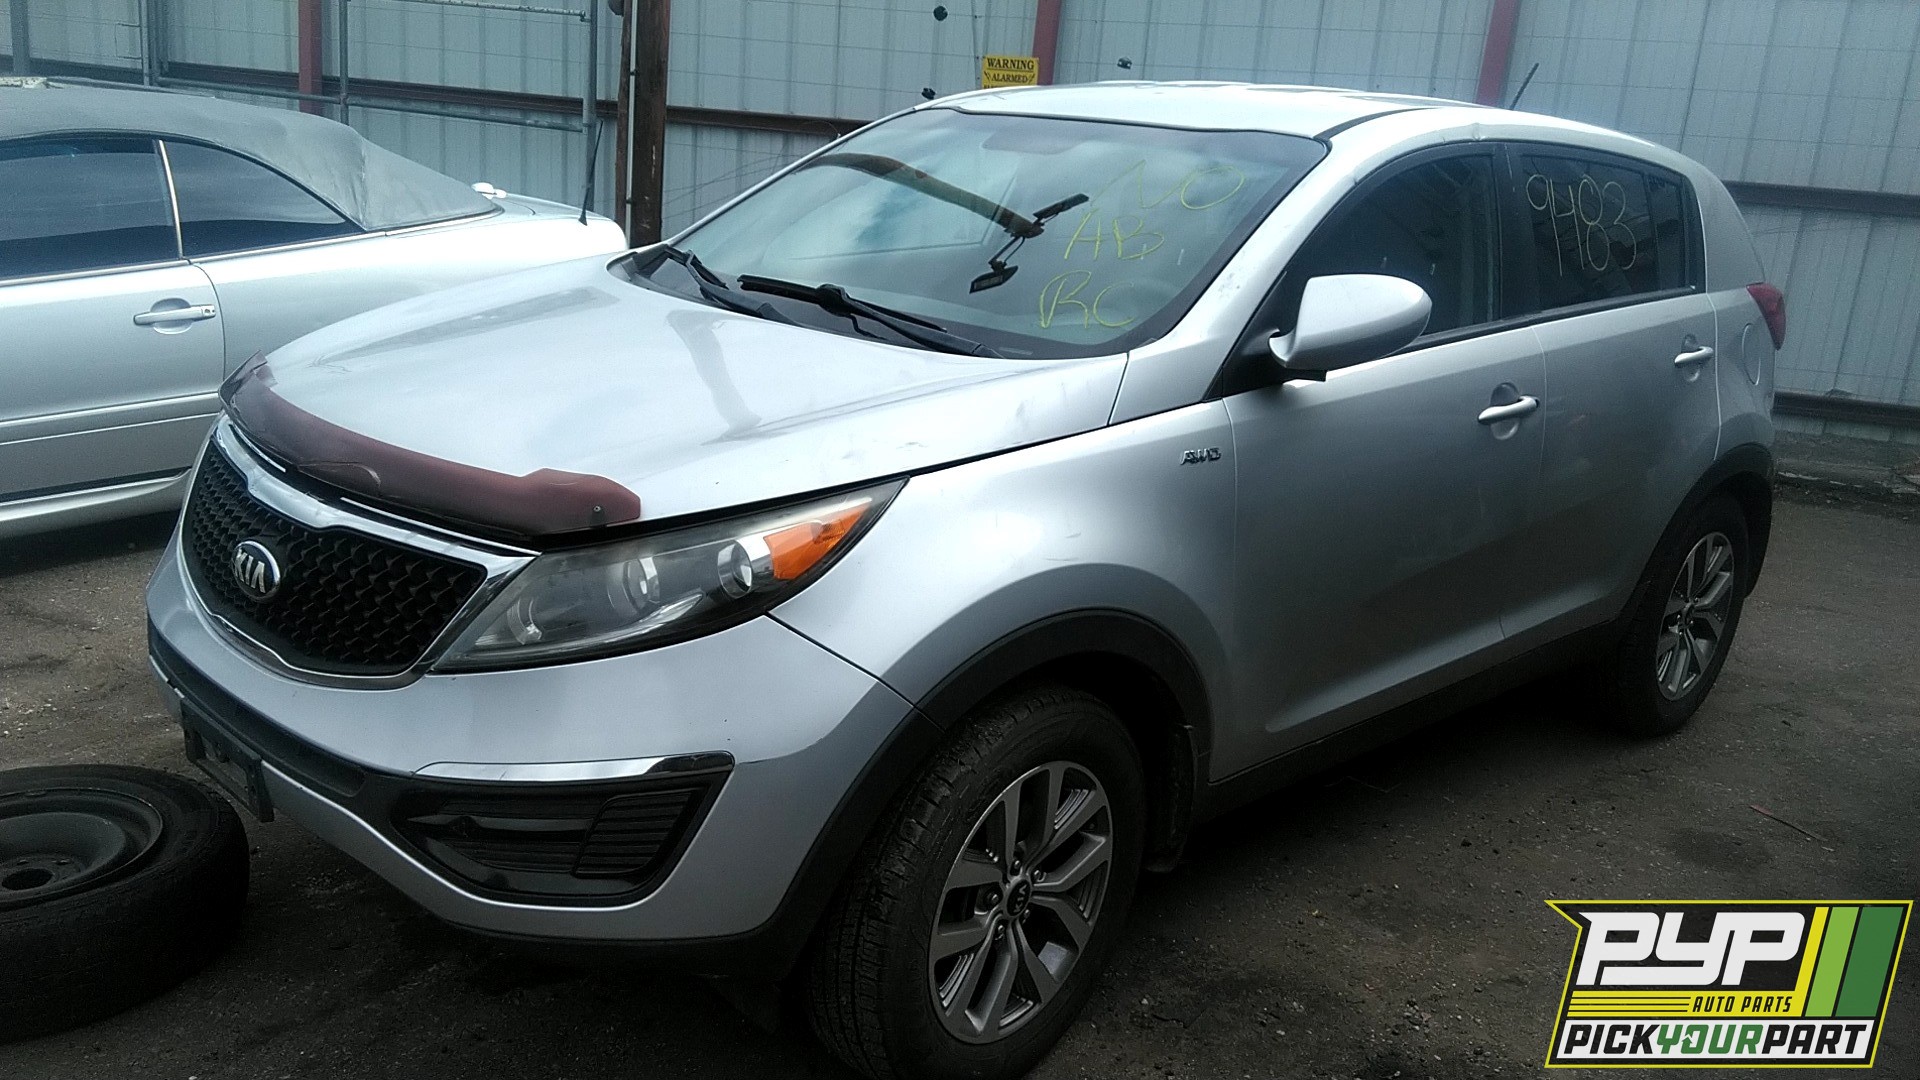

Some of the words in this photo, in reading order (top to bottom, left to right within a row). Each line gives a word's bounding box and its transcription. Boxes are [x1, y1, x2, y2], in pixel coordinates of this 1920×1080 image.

[986, 57, 1034, 70] WARNING
[992, 73, 1028, 83] ALARMED
[1063, 208, 1165, 261] AB
[1526, 173, 1637, 277] 9483
[1180, 447, 1221, 465] AWD
[234, 546, 266, 594] KIA
